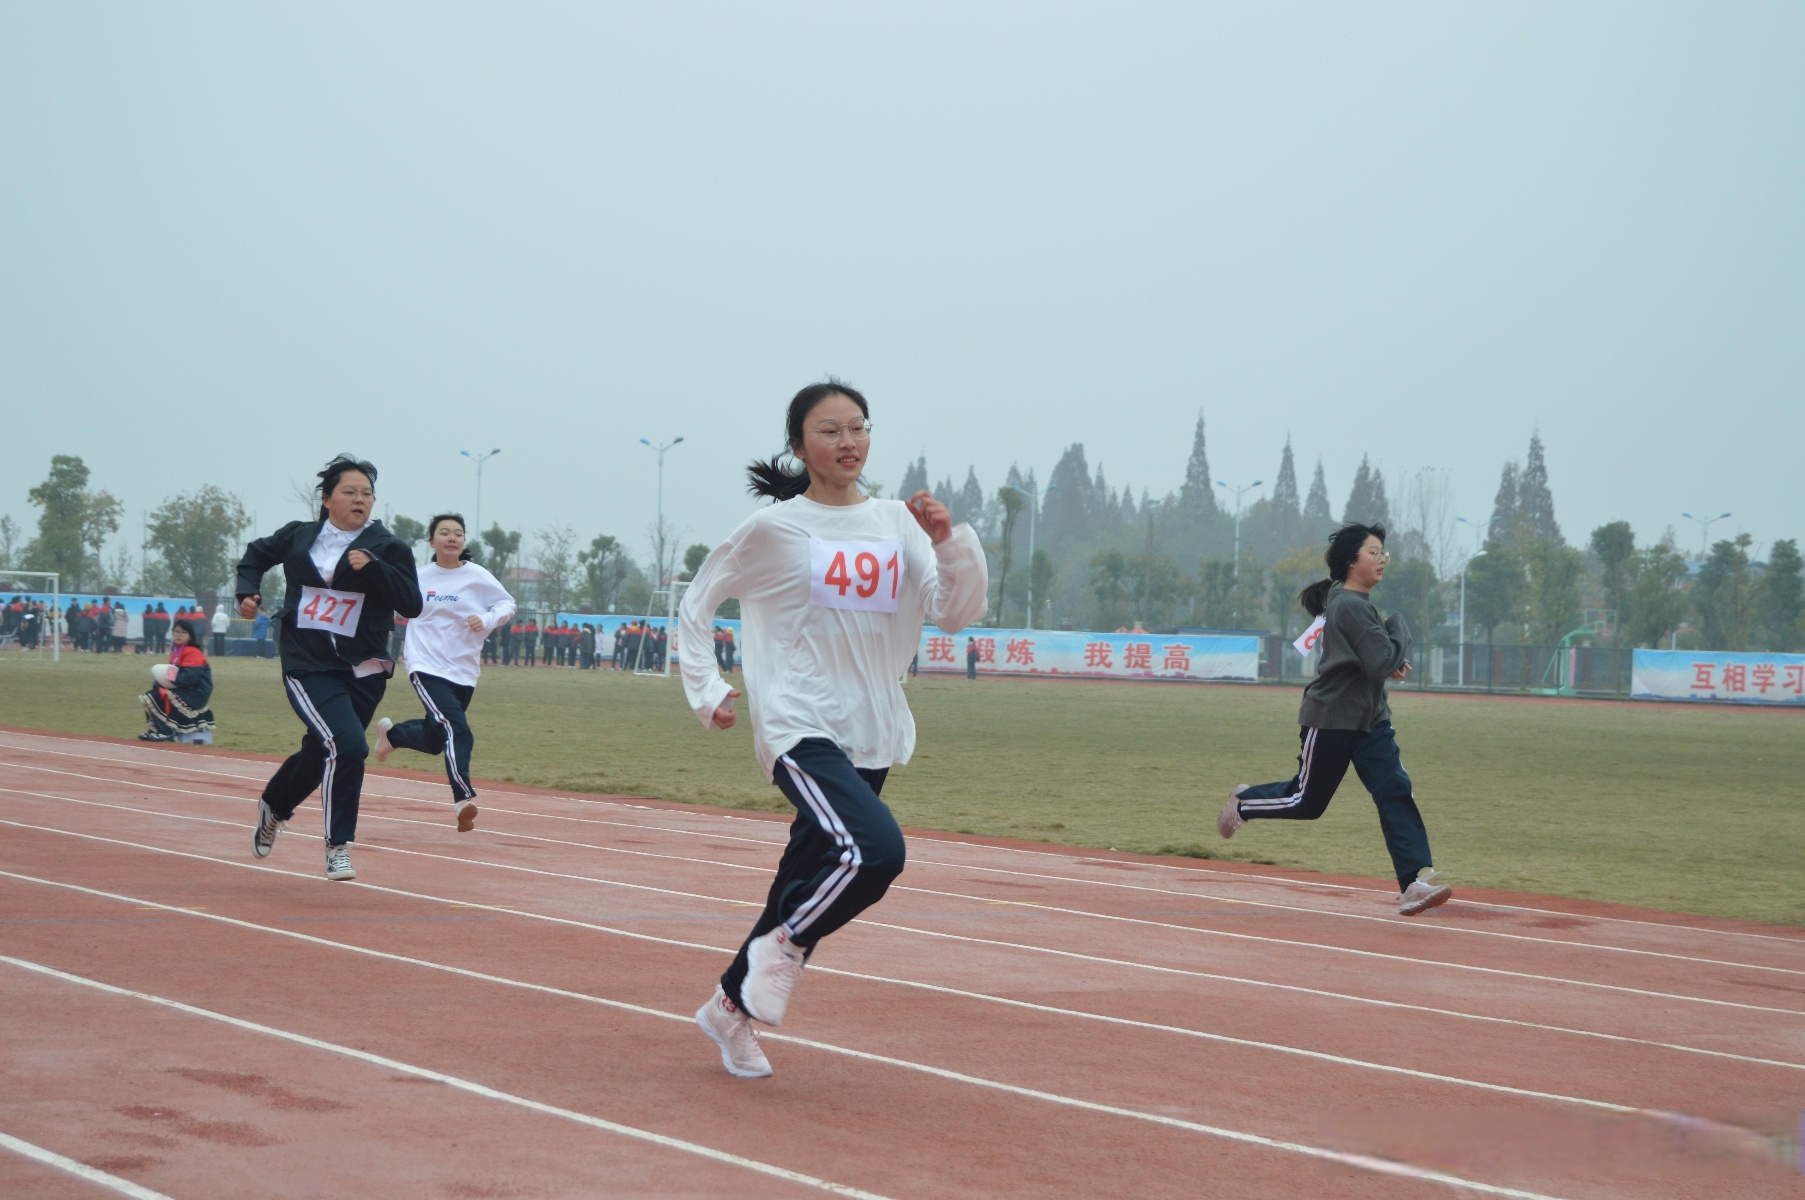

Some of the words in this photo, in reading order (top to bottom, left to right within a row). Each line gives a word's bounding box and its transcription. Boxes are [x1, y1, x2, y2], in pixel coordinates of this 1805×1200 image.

[824, 550, 899, 599] 491
[303, 594, 358, 627] 427
[1083, 641, 1193, 672] 我提高
[1690, 662, 1804, 694] 互相学习
